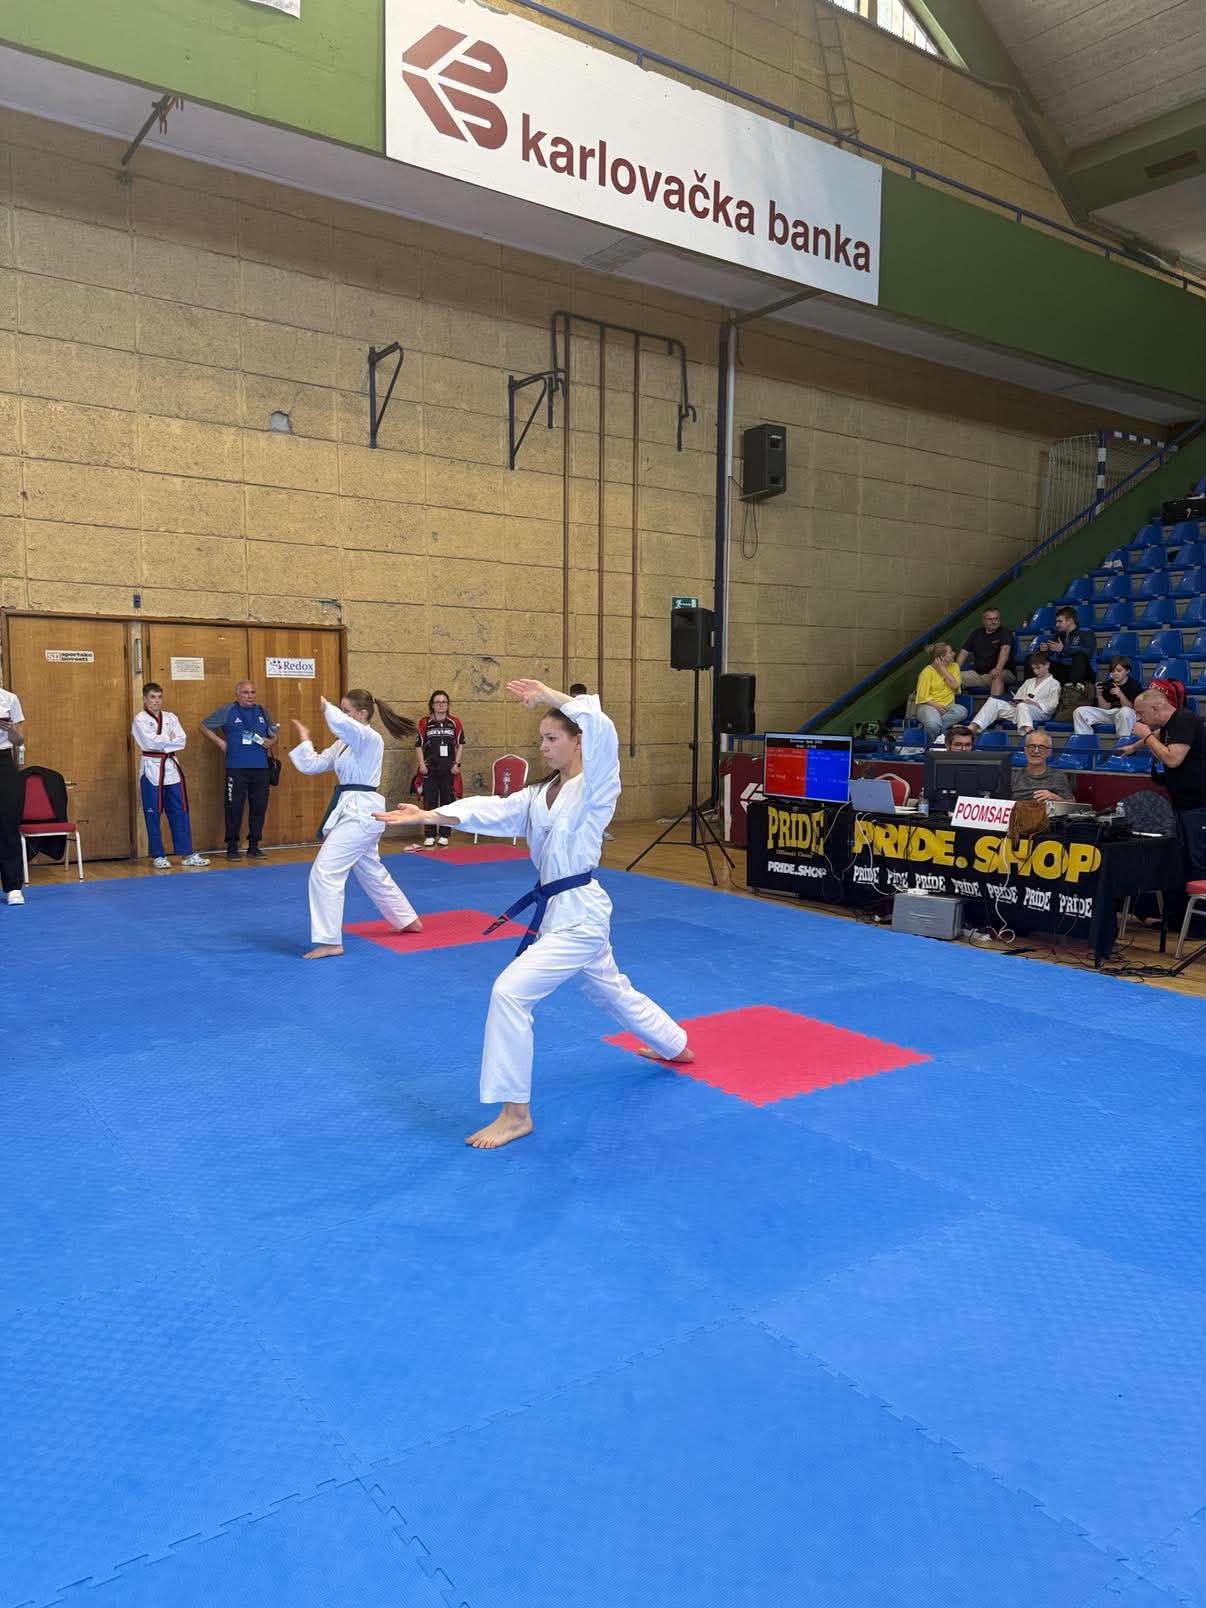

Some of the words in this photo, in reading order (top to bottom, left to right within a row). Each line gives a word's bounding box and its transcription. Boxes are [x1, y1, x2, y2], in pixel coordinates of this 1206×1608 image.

[521, 112, 755, 235] karlovačka
[768, 200, 871, 273] banka
[284, 660, 313, 671] Redox
[767, 805, 824, 857] PRIDE
[955, 802, 1011, 825] POOMSAE
[767, 861, 827, 878] PRIDE.SHOP
[853, 864, 880, 884] PRIDE
[914, 872, 946, 893] PRIDE
[950, 877, 983, 898] PRIDE
[986, 882, 1018, 904] PRIDE
[1023, 886, 1052, 912] PRIDE
[1058, 892, 1093, 919] PRIDE
